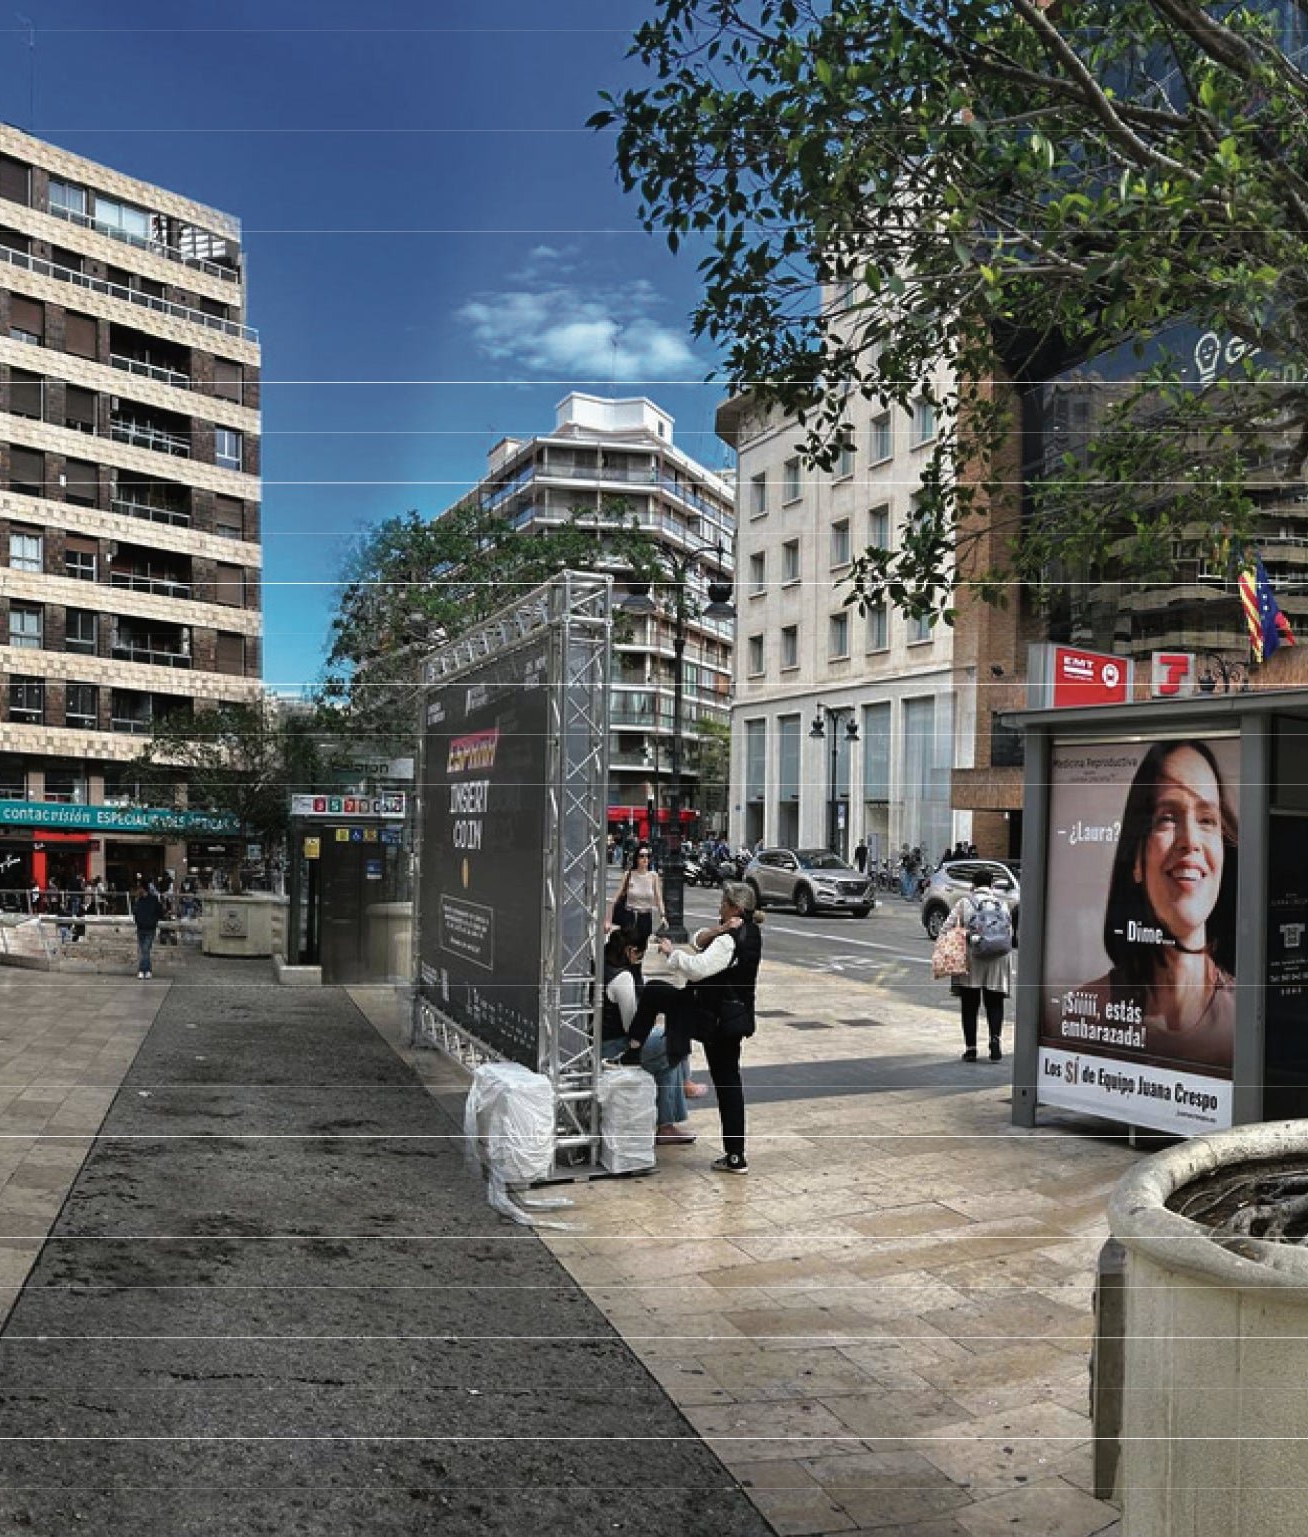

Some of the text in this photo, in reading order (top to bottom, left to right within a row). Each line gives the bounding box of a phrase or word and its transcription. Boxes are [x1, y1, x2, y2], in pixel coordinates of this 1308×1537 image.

[1063, 656, 1094, 669] EMT
[450, 780, 489, 813] INSERT
[453, 819, 483, 850] COIN
[1069, 820, 1122, 845] ¿Laura?
[1105, 998, 1142, 1024] estás
[1061, 1016, 1147, 1048] embarazada!
[1044, 1057, 1062, 1077] Los
[1082, 1065, 1096, 1084] de
[1099, 1067, 1135, 1095] Equipo
[1137, 1076, 1172, 1101] Juana
[1174, 1082, 1218, 1113] Crespo
